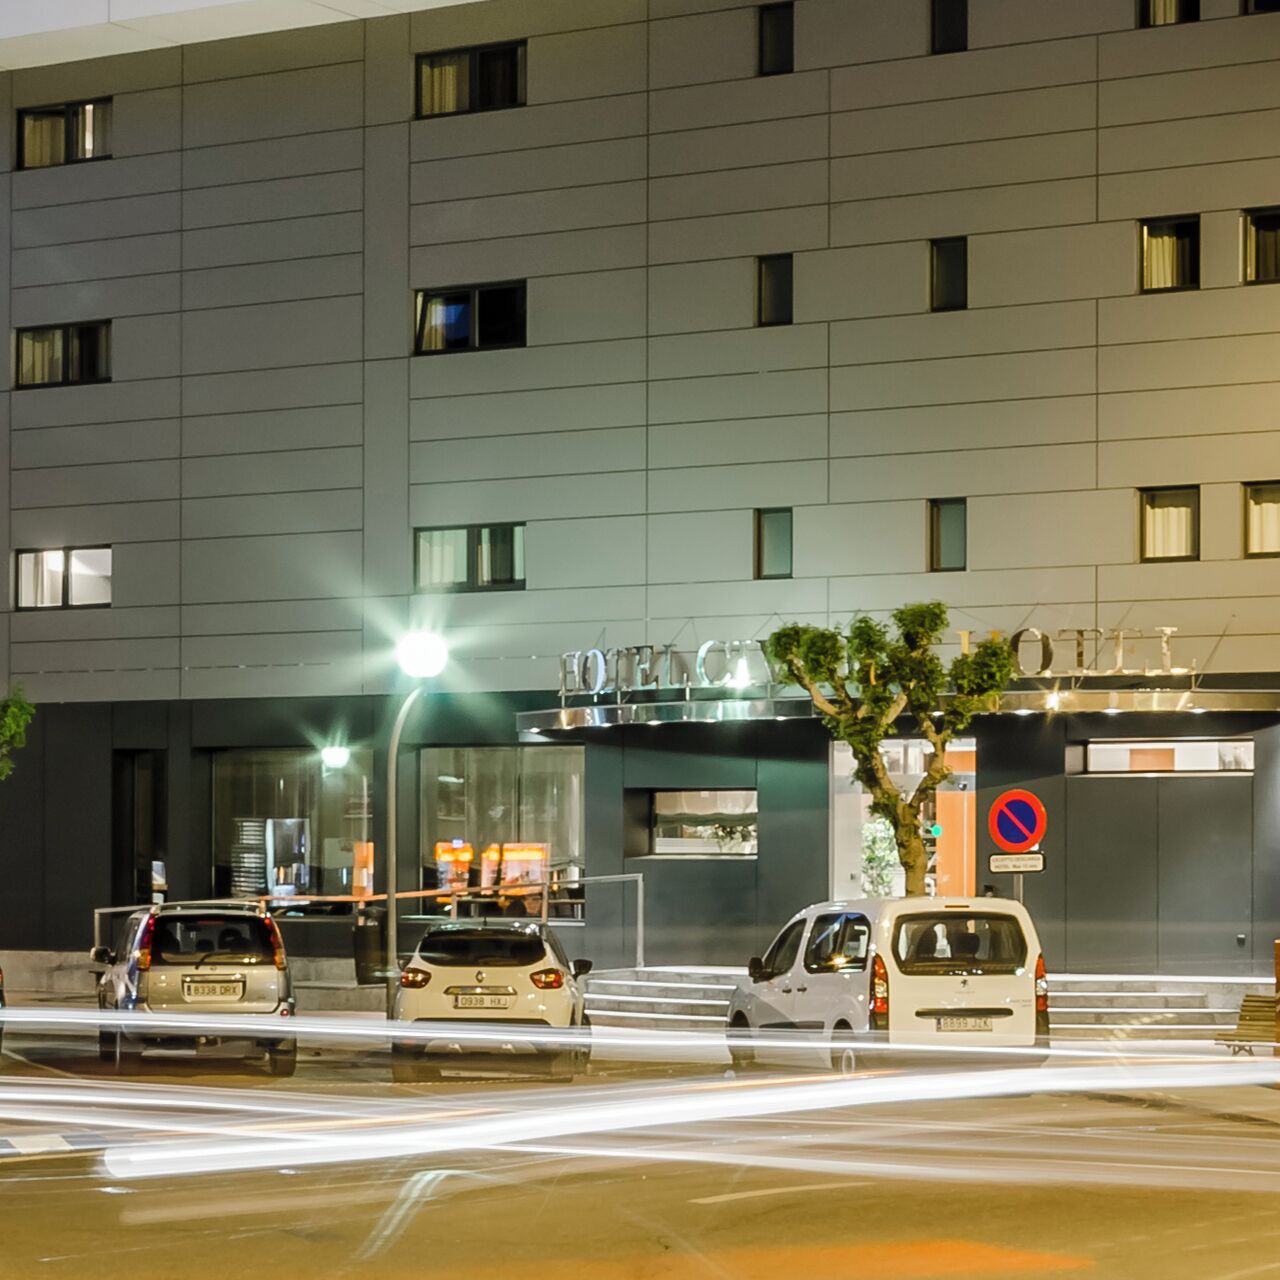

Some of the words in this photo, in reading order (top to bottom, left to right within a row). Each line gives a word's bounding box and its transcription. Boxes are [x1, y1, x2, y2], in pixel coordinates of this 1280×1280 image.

[558, 643, 688, 695] HOTEL
[193, 985, 217, 995] 8338
[460, 996, 485, 1006] 0938
